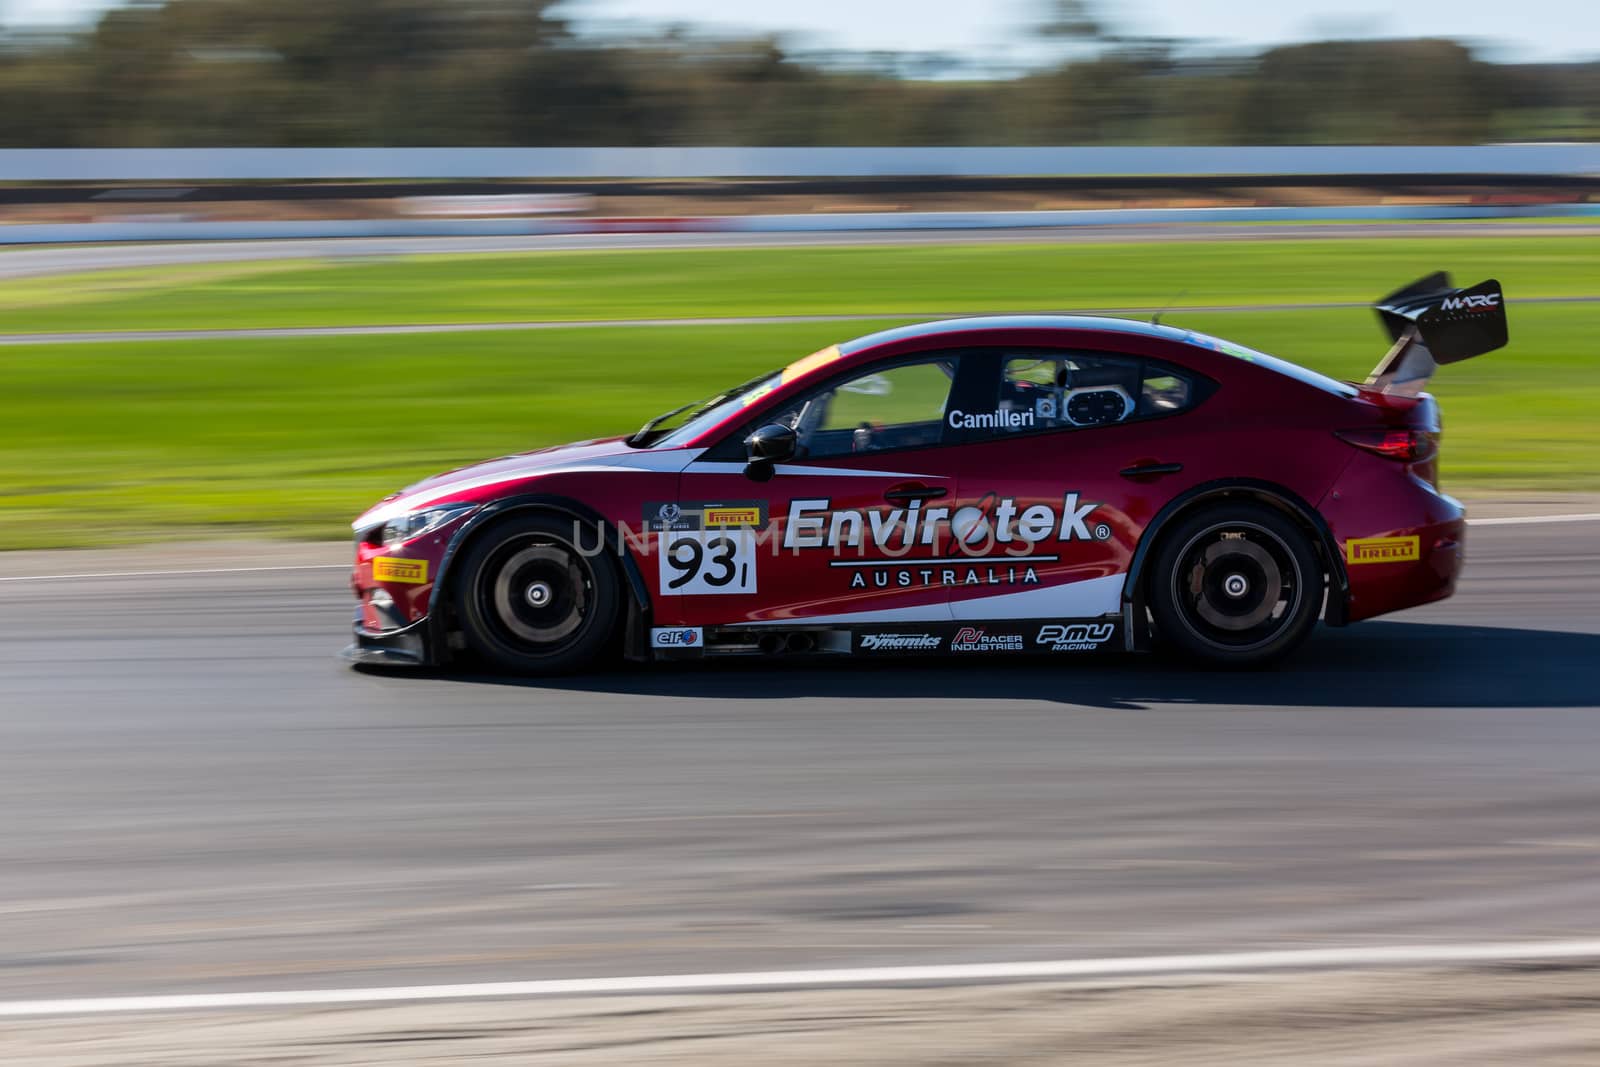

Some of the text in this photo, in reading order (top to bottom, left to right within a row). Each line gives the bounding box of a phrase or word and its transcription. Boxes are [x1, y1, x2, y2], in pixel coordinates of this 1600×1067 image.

[1440, 293, 1500, 311] MARC
[948, 408, 1034, 428] Camilleri
[709, 511, 755, 523] PIRELLI
[1353, 541, 1414, 559] PIRELLI
[377, 562, 422, 578] PIRELLI
[851, 568, 1038, 587] AUSTRALIA
[656, 630, 684, 645] elf
[860, 633, 943, 651] Dynamics
[980, 635, 1023, 644] RACER
[950, 643, 1024, 652] INDUSTRIES
[1051, 643, 1098, 651] RACING
